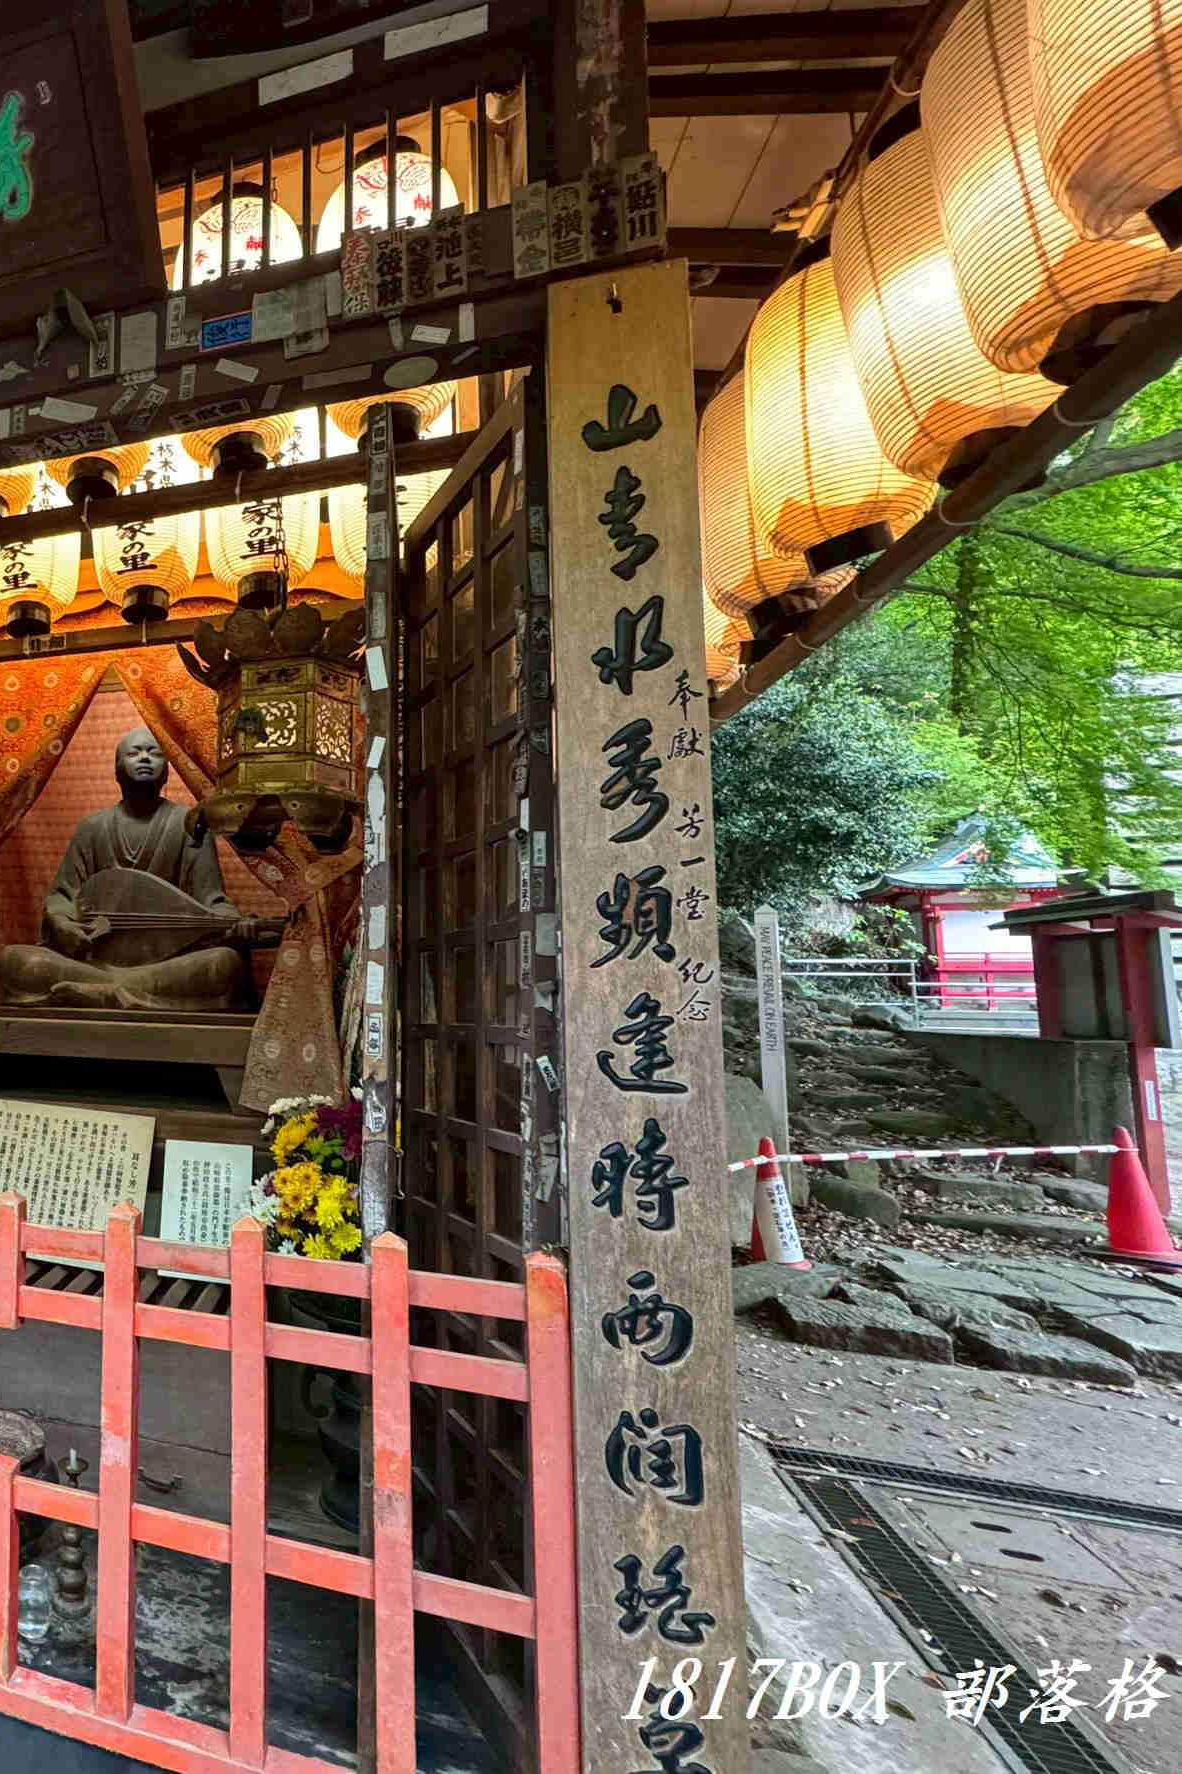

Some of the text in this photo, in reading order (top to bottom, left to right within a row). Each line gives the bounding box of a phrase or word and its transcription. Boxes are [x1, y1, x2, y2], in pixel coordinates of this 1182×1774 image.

[674, 804, 710, 921] 芳一堂
[676, 957, 715, 1022] 紀念
